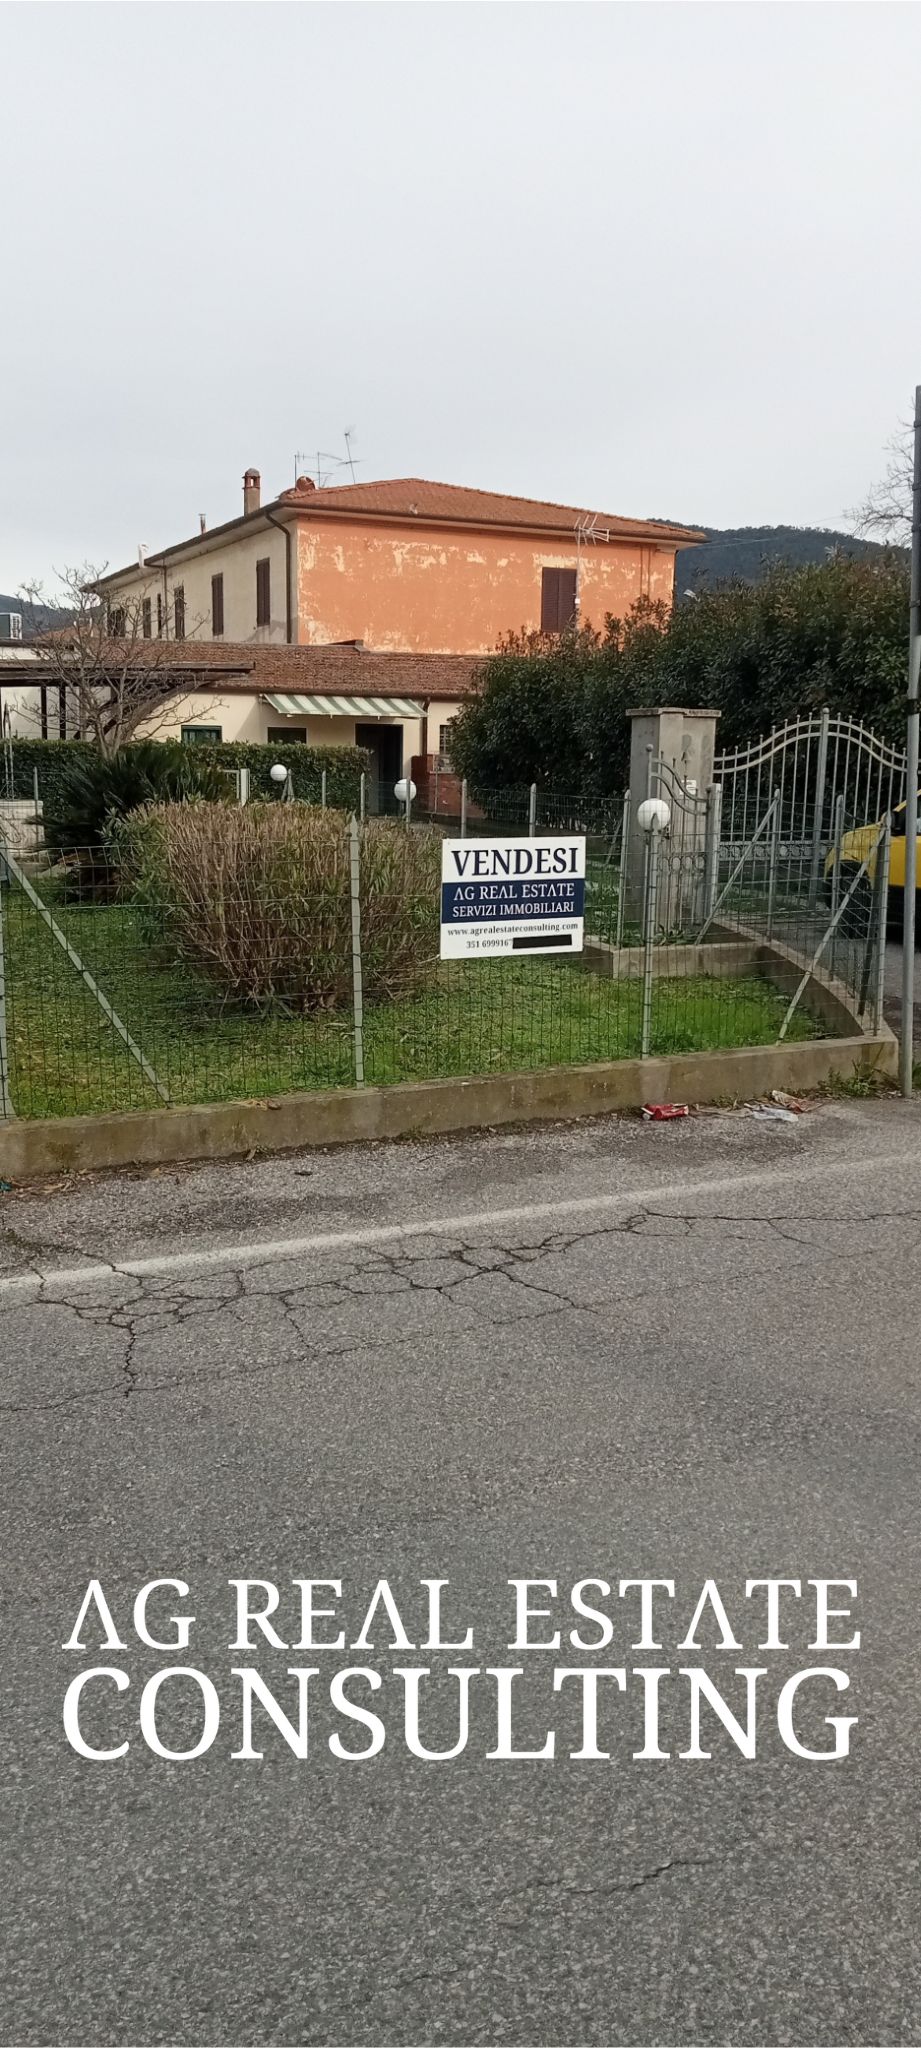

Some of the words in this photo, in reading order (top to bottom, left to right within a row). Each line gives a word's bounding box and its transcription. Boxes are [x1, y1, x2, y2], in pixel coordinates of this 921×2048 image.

[451, 848, 578, 876] VENDESI
[453, 887, 475, 901] AG
[480, 884, 517, 900] REAL
[522, 883, 575, 897] ESTATE
[453, 905, 496, 917] SERVIZI
[500, 902, 574, 915] IMMOBILIARI
[448, 923, 578, 935] www.agrealestateconsulting.com
[466, 940, 480, 949] 351
